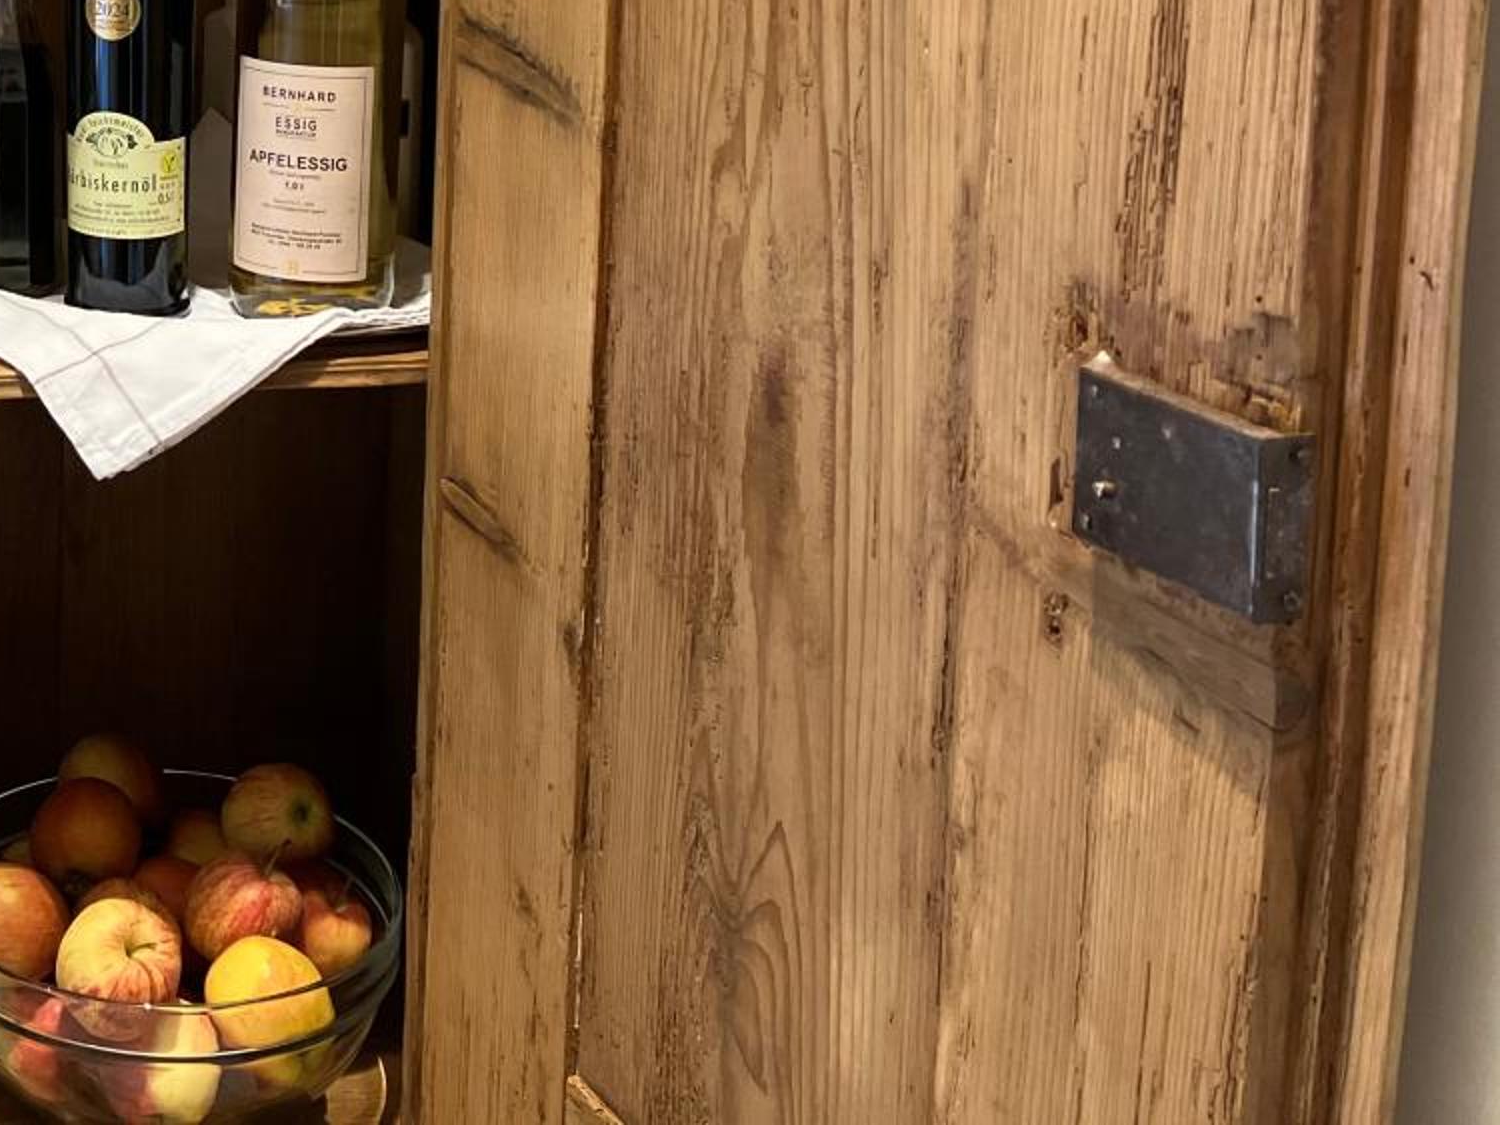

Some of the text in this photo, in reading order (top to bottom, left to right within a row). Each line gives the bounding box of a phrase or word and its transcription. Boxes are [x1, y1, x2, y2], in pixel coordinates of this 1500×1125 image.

[262, 85, 337, 103] BERNHARD
[275, 115, 317, 132] ESSIG
[249, 148, 348, 172] APFELESSIG
